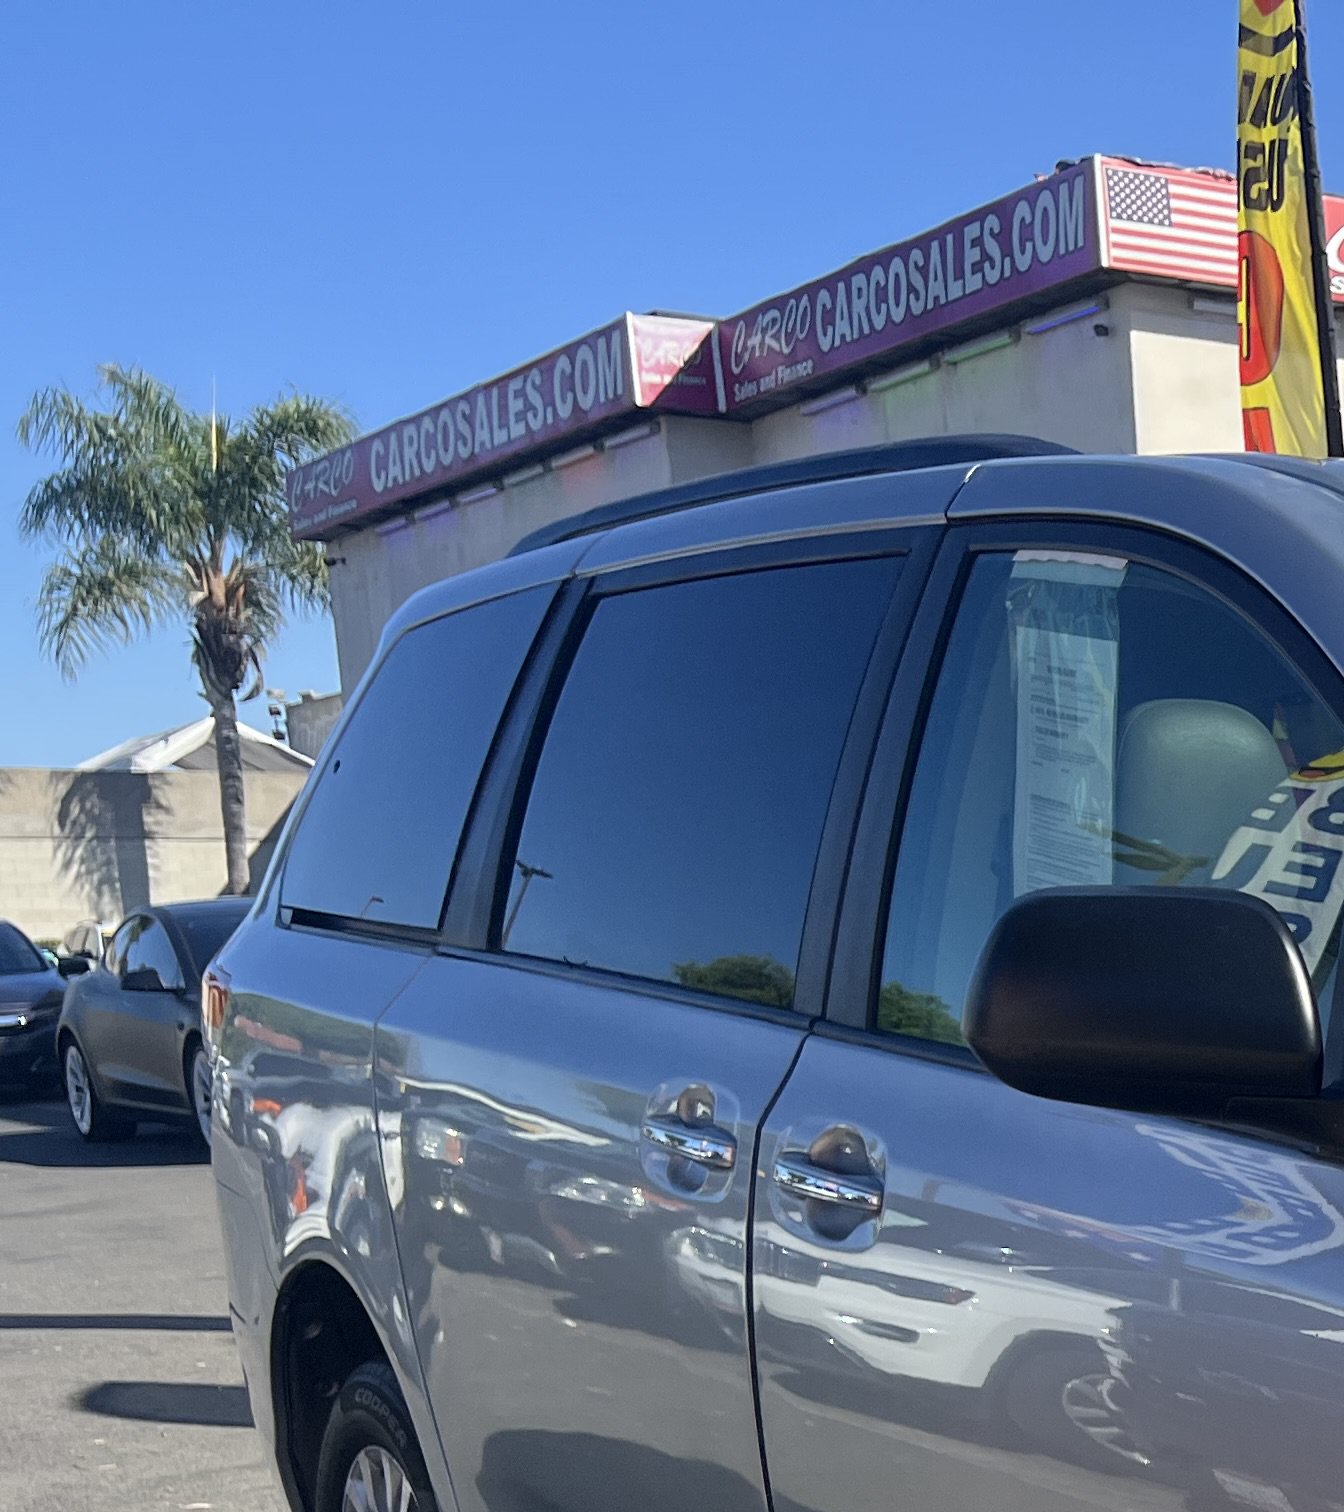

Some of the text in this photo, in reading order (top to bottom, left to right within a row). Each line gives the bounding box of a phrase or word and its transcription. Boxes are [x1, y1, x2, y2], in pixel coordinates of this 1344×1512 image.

[731, 293, 812, 376] CARCO
[815, 174, 1085, 353] CARCOSALES.COM
[370, 328, 625, 494] CARCOSALES.COM
